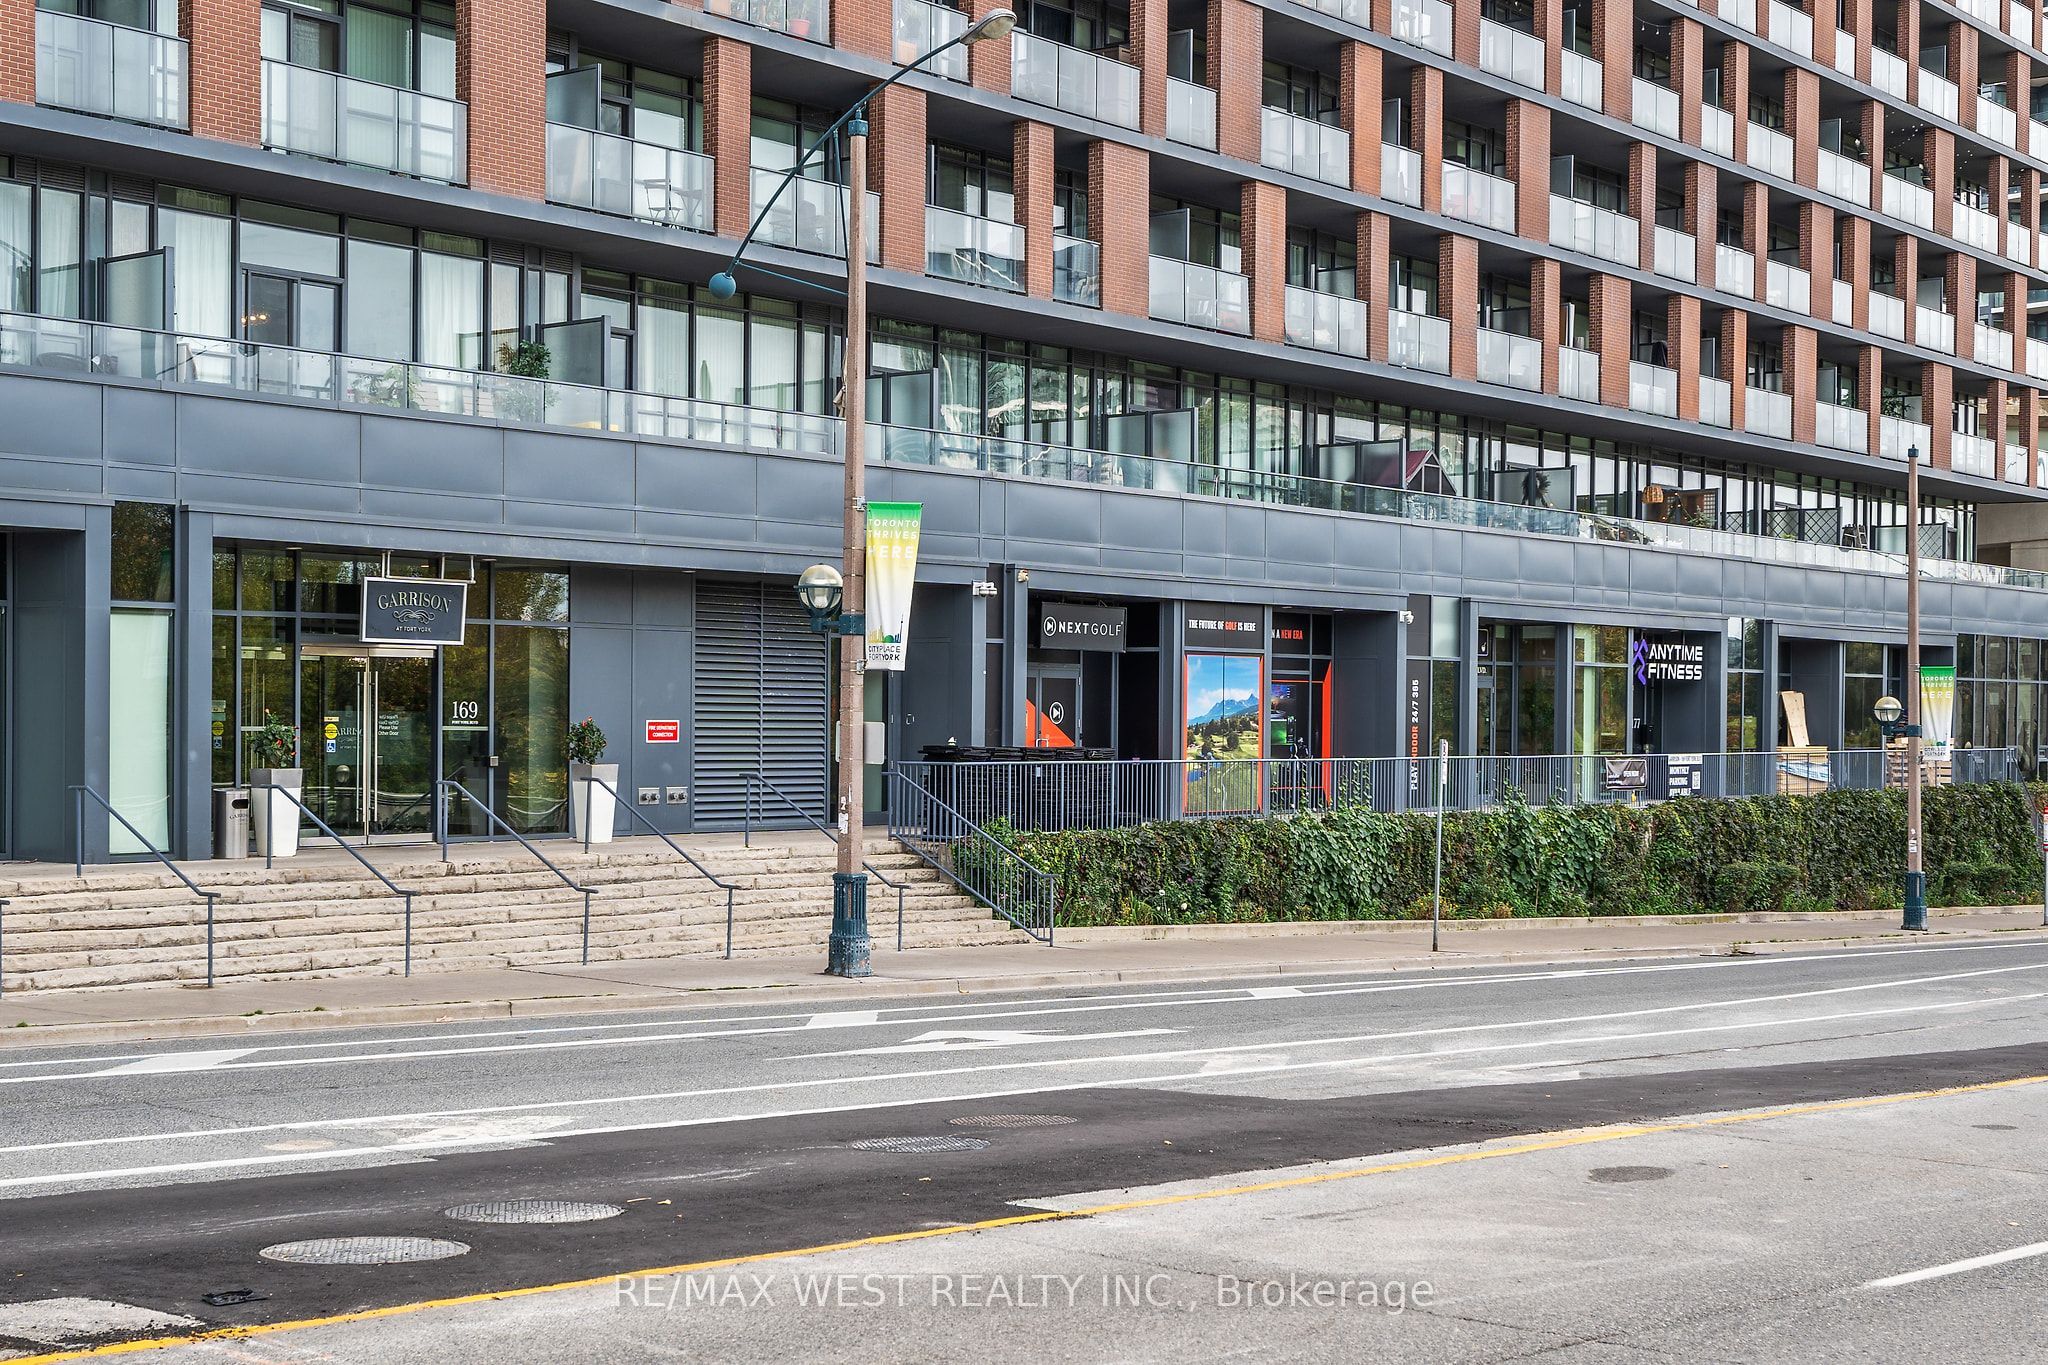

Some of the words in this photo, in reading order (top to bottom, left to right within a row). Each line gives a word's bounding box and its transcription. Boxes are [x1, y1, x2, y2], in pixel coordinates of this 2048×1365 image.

[868, 518, 919, 528] TORONTO
[868, 529, 918, 539] THRIVES
[867, 545, 914, 560] HERE
[378, 591, 452, 613] GARRISON
[1188, 619, 1198, 629] THE
[1198, 620, 1217, 630] FUTURE
[1217, 621, 1225, 631] OF
[1225, 621, 1237, 632] GOLF
[1237, 622, 1244, 631] IS
[1244, 622, 1256, 632] HERE
[1275, 629, 1281, 639] A
[1281, 629, 1293, 639] NEW
[1293, 629, 1304, 640] ERA
[1648, 643, 1703, 662] ANYTIME
[1647, 662, 1703, 680] FITNESS
[1411, 679, 1419, 698] 365
[452, 701, 478, 719] 169
[1411, 700, 1419, 723] 24/7
[1411, 725, 1419, 763] INDOOR
[1411, 765, 1419, 790] PLAY
